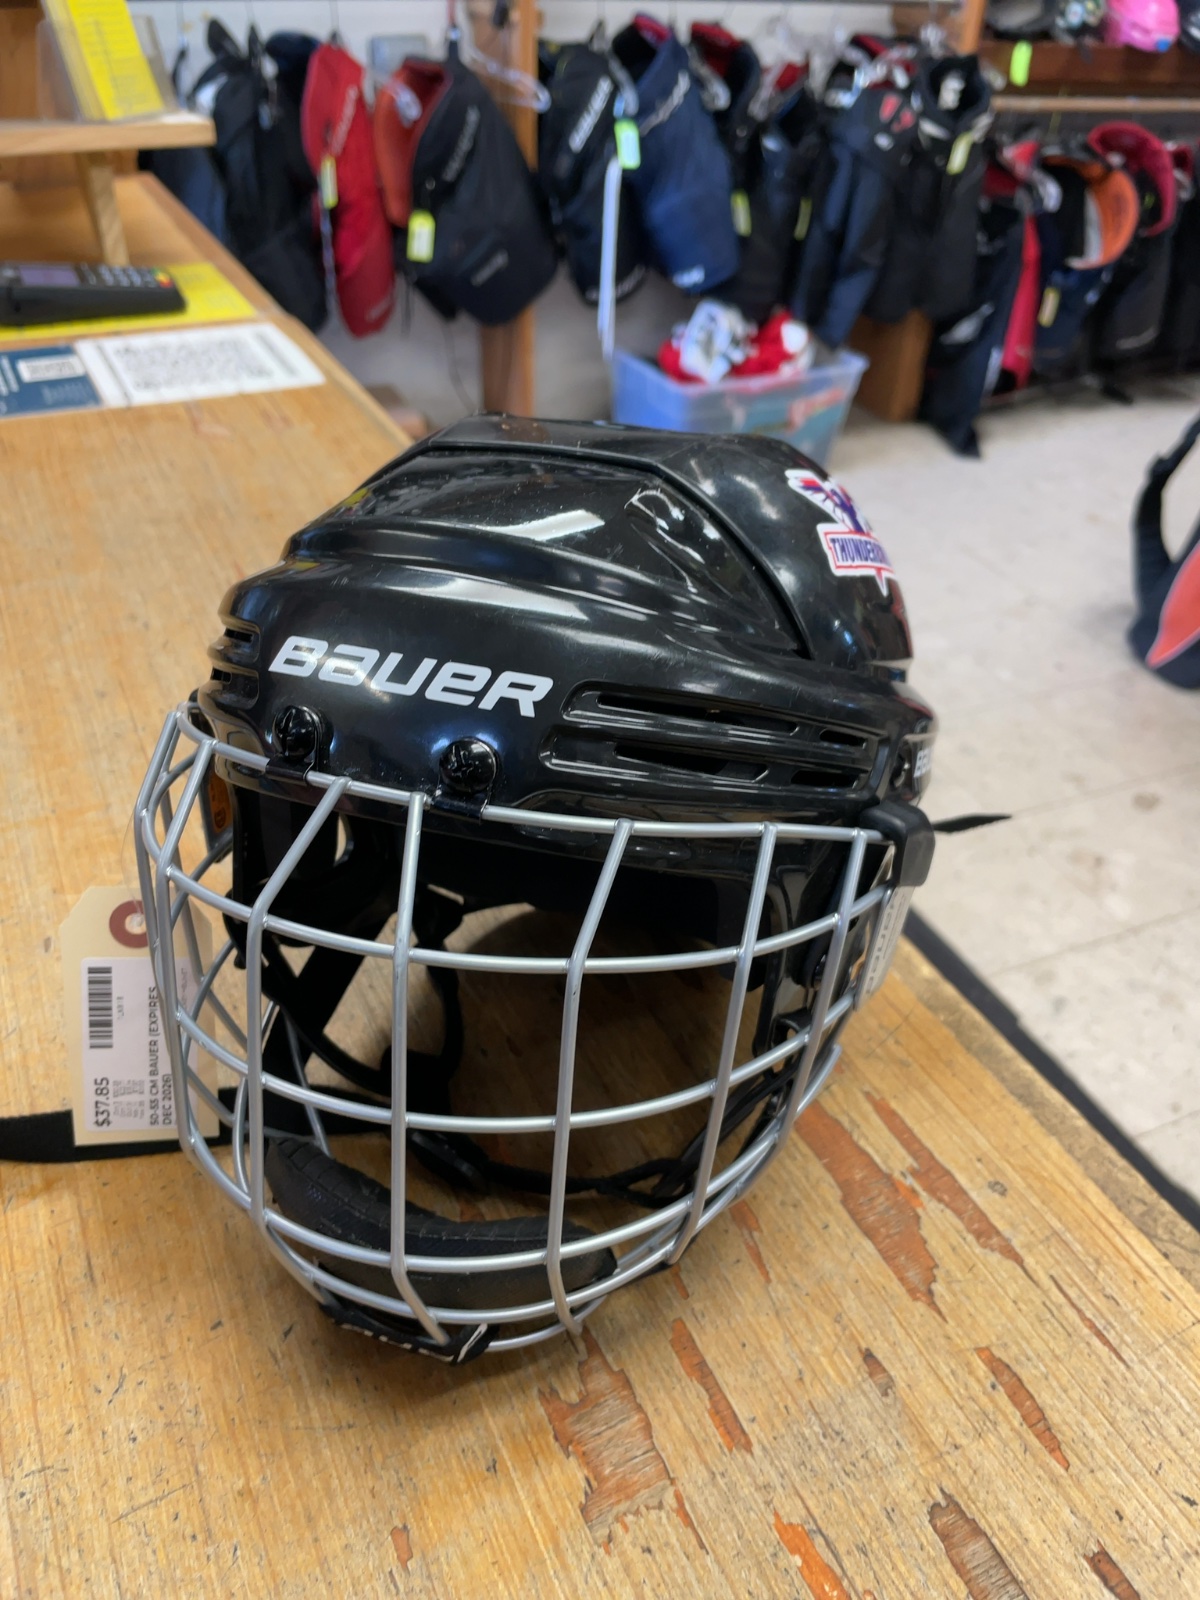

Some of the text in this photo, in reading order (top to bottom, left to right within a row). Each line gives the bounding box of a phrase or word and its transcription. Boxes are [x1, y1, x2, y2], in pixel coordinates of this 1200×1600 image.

[268, 635, 554, 718] BAUER
[149, 986, 160, 1036] (EXPIRES
[149, 1041, 159, 1076] BAUER
[93, 1076, 111, 1127] $37.85
[149, 1079, 159, 1096] CM
[162, 1073, 172, 1125] DEC 2026)
